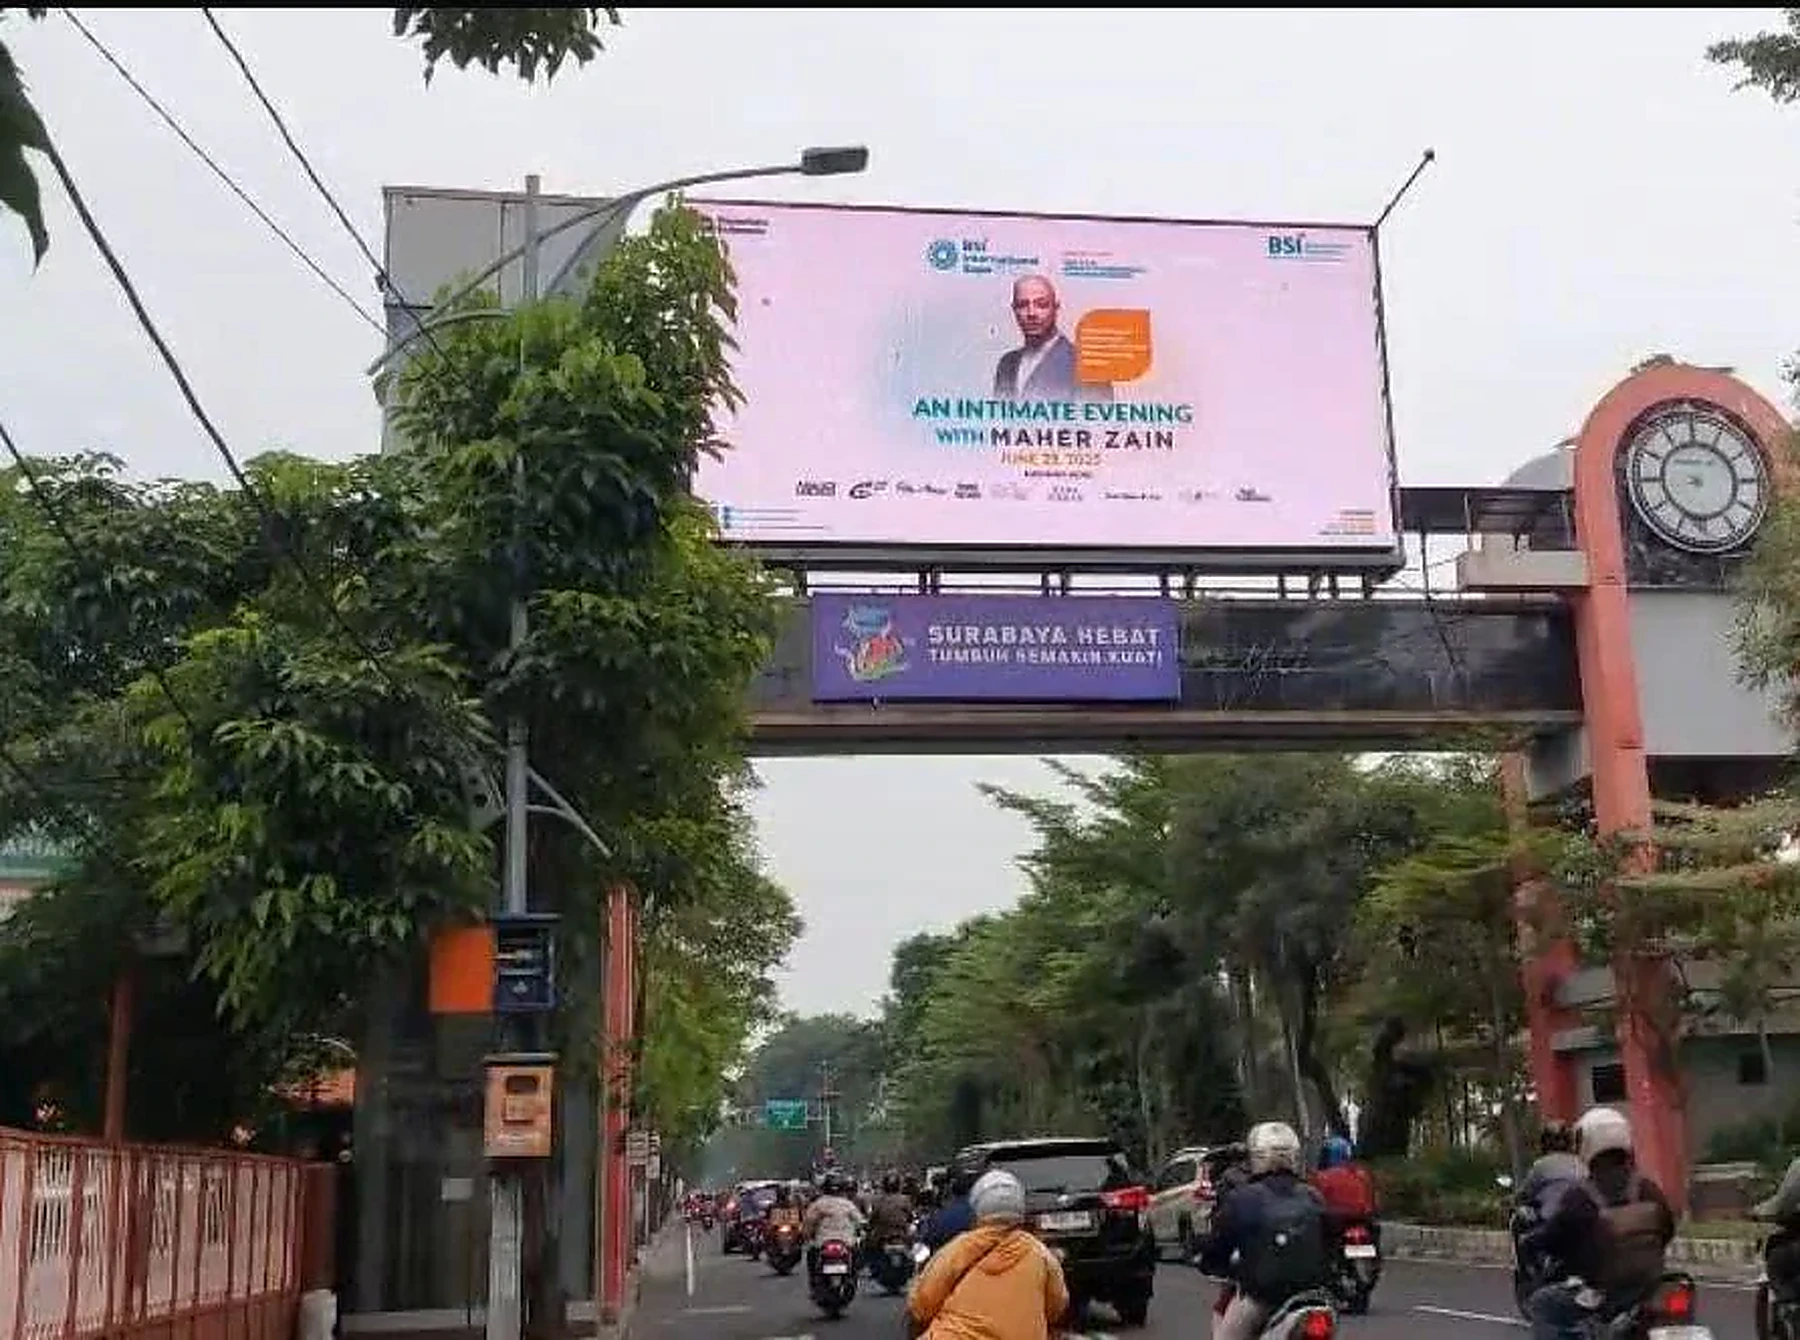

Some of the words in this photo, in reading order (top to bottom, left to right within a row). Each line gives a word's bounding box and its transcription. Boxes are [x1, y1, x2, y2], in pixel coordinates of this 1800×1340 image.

[1269, 233, 1305, 254] BSI
[912, 399, 951, 419] AN
[957, 399, 1077, 421] INTIMATE
[1084, 402, 1193, 423] EVENING
[936, 427, 983, 444] WITH
[990, 428, 1092, 448] MAHER
[1105, 430, 1174, 449] ZAIN
[928, 626, 1067, 645] SURABAYA
[1077, 627, 1160, 646] HEBAT
